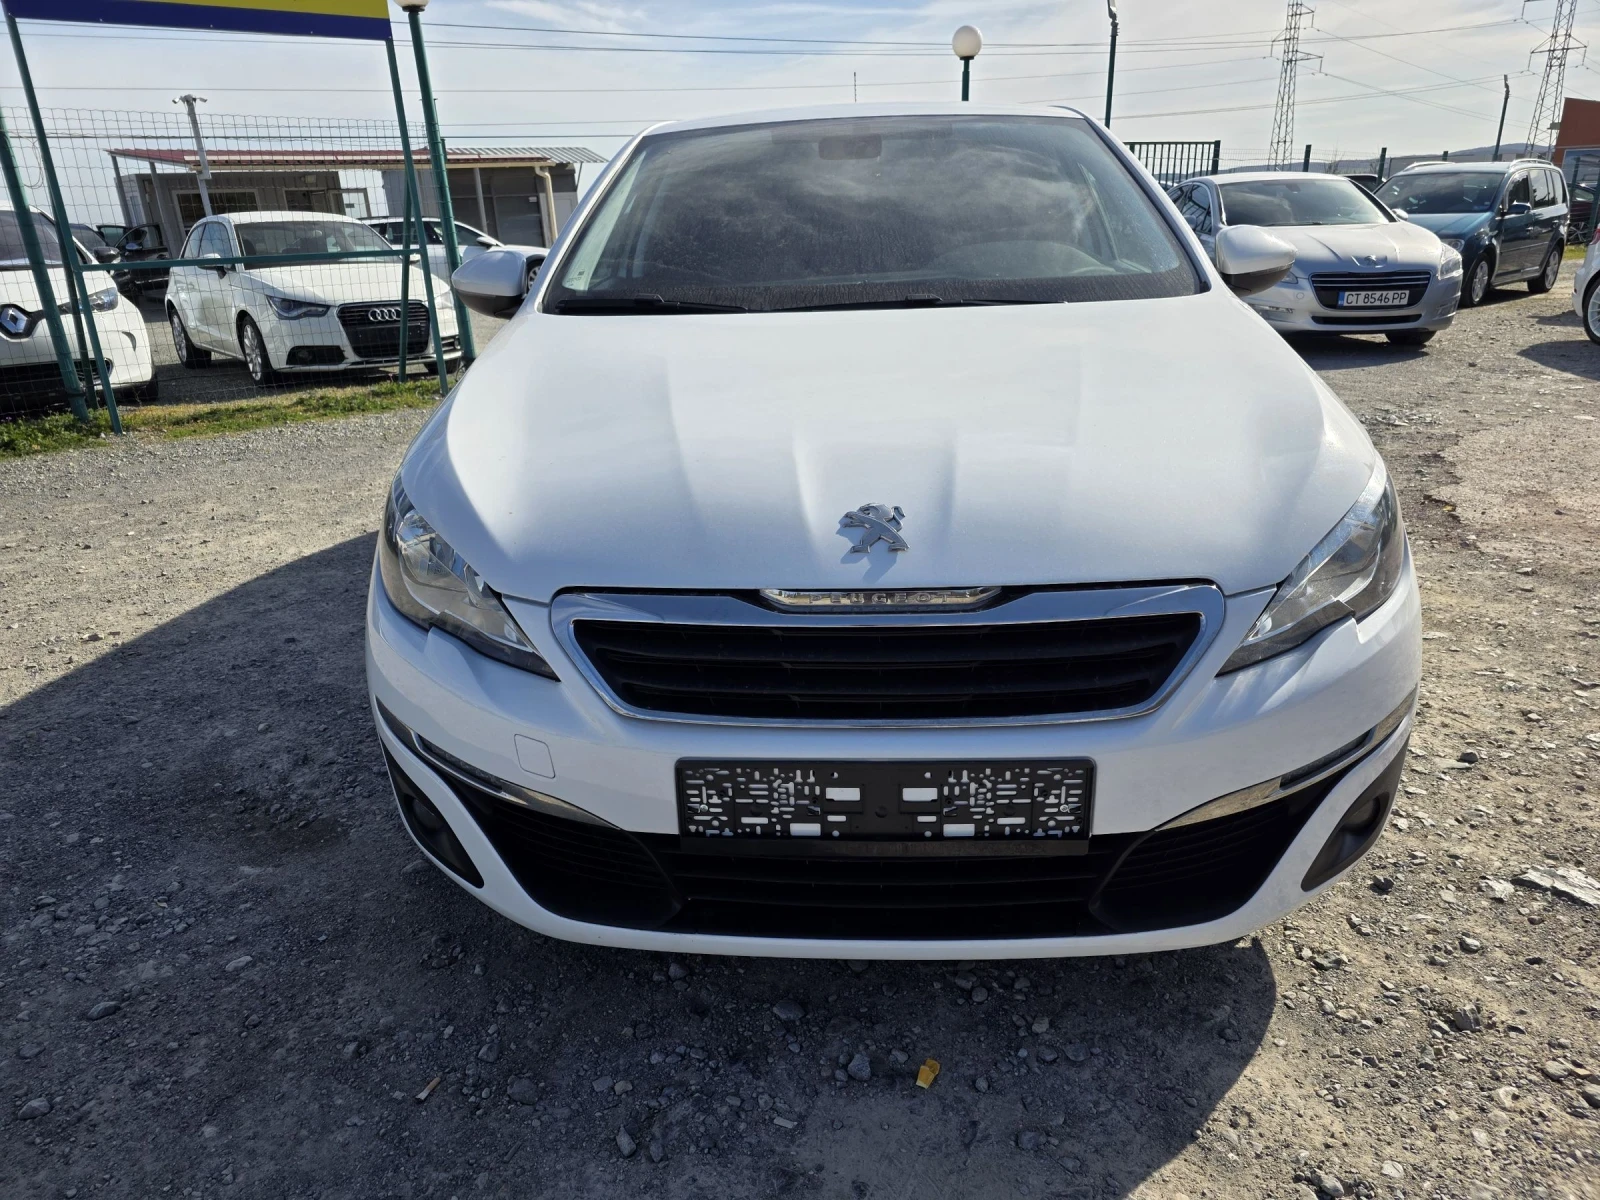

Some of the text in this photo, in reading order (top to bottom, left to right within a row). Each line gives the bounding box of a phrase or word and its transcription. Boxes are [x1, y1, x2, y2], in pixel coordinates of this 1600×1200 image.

[1346, 293, 1361, 305] CT
[1363, 292, 1390, 304] 8546
[1392, 291, 1407, 304] PP
[808, 591, 952, 605] PEUGEOT
